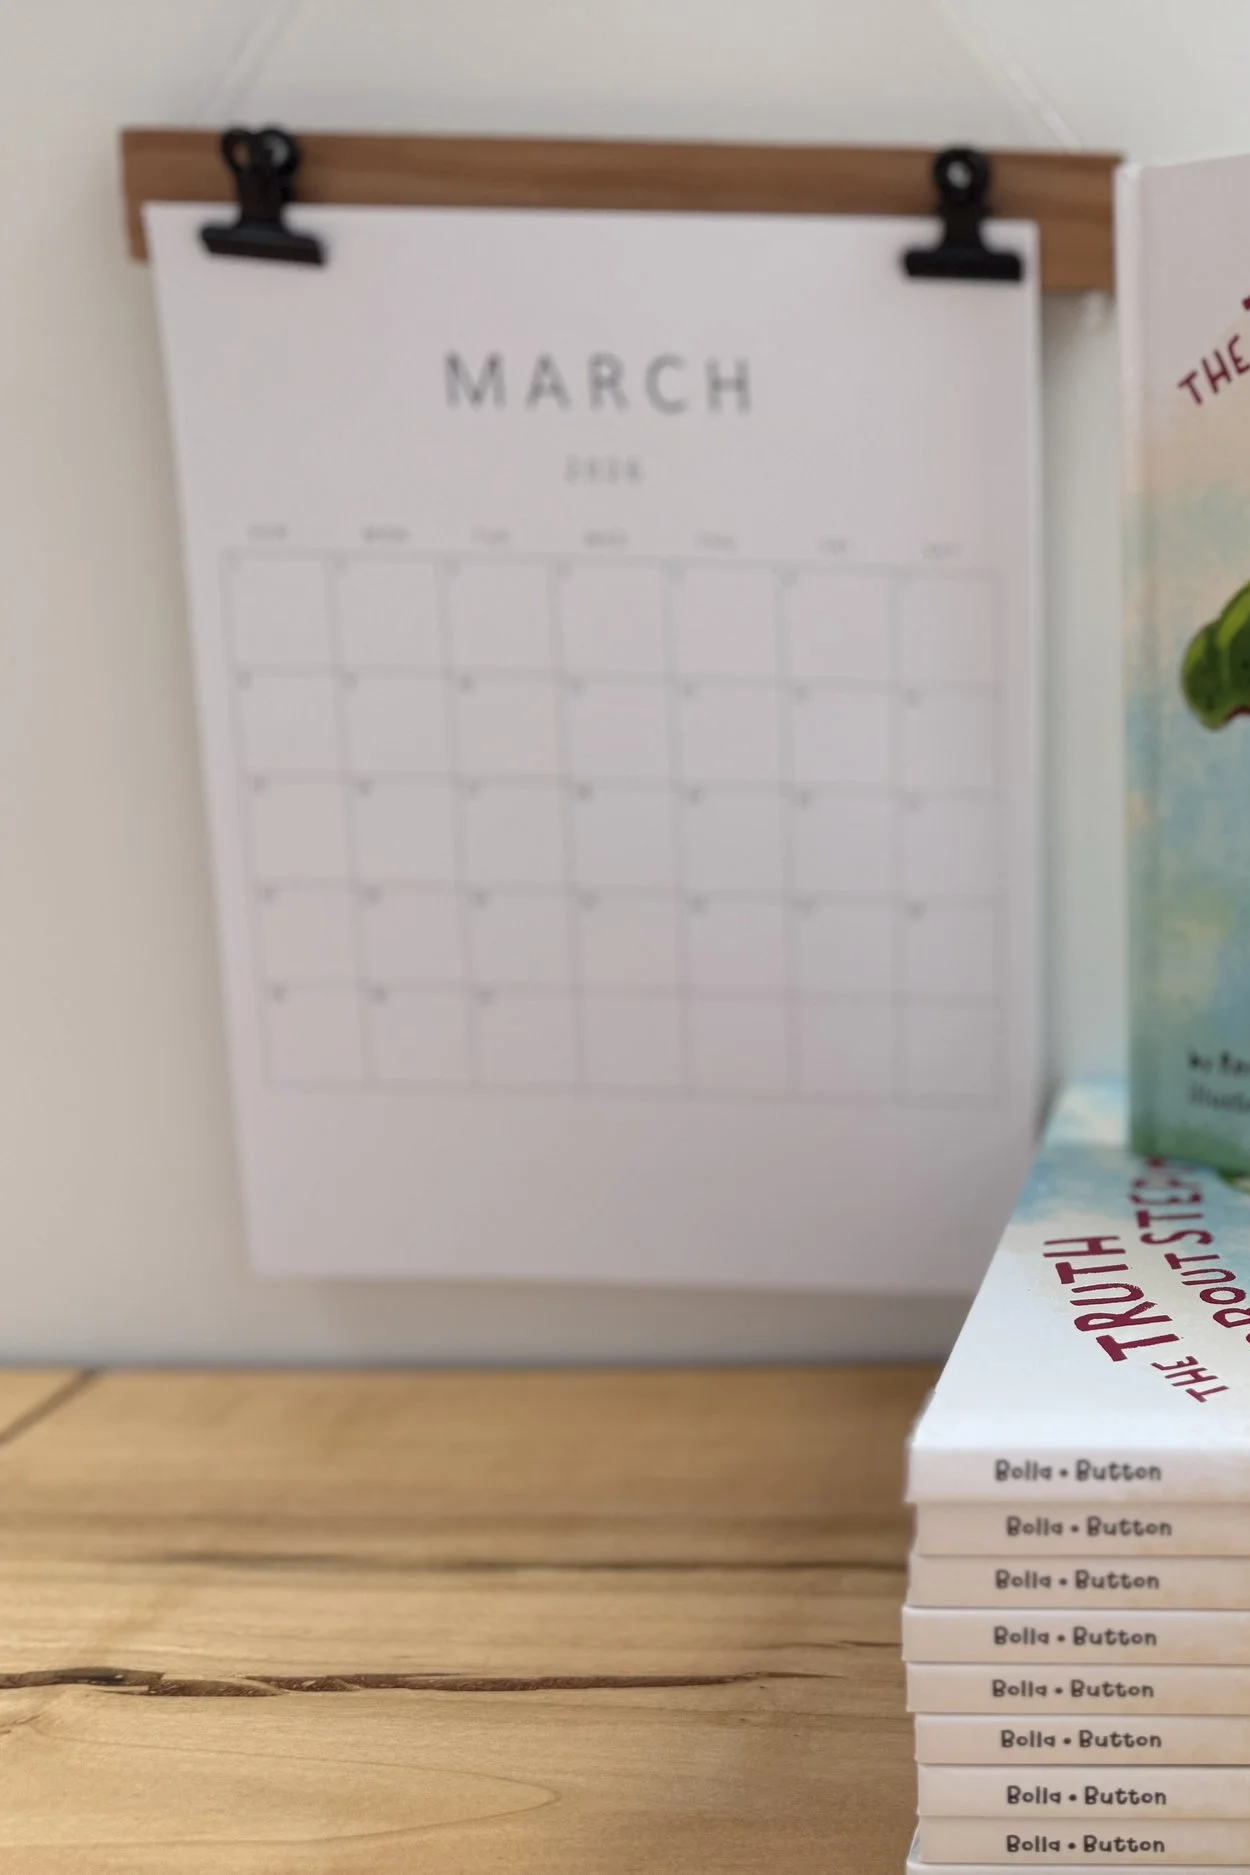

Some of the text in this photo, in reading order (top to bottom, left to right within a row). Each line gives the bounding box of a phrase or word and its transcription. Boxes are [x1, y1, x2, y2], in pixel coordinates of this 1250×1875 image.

[443, 350, 752, 416] MARCH
[1043, 1234, 1229, 1403] THE TRUTH
[994, 1457, 1162, 1482] Bolla Button
[1006, 1515, 1172, 1537] Bolla Button
[995, 1569, 1160, 1590] Bolla Button
[993, 1625, 1158, 1647] Bolla Button
[991, 1678, 1155, 1698] Bolla Button
[1000, 1728, 1162, 1749] Bolla Button
[1006, 1784, 1167, 1806] Bolla Button
[1006, 1834, 1166, 1854] Bolla Button
